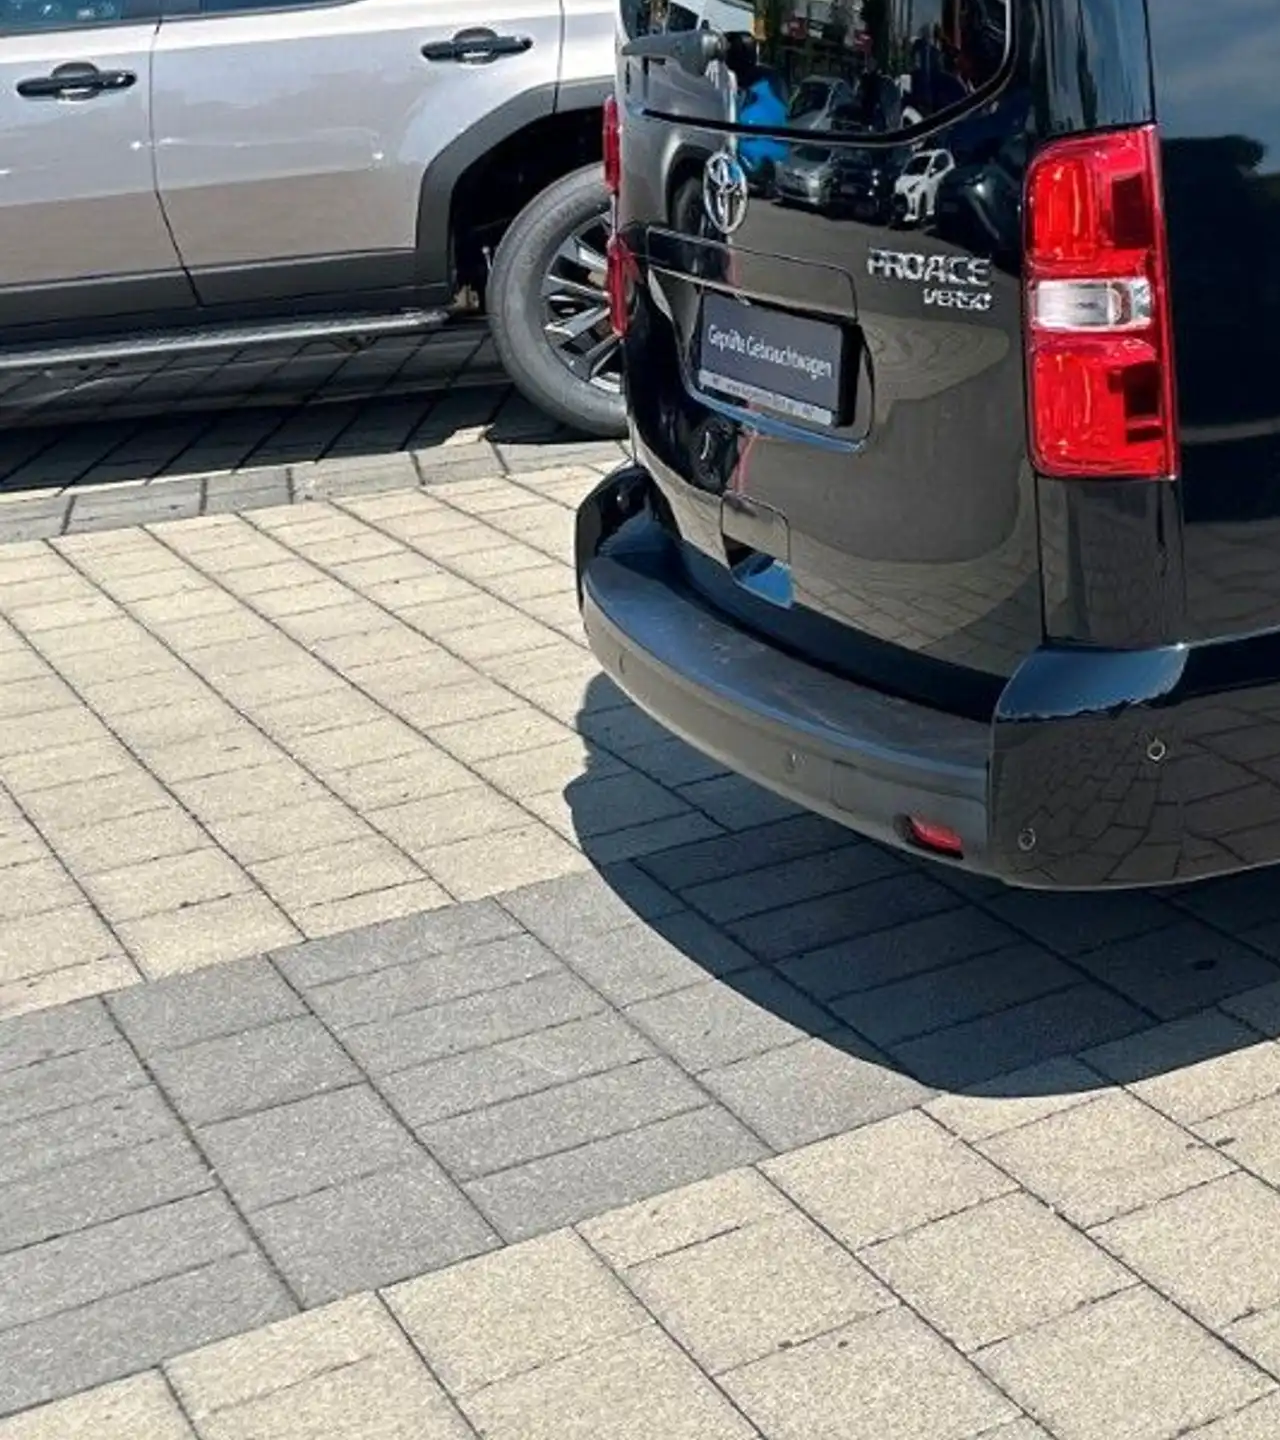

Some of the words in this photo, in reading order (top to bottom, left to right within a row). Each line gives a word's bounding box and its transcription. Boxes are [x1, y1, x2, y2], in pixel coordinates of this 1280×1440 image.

[866, 247, 990, 286] PROACE
[923, 288, 992, 311] VERSO
[746, 335, 832, 380] Gebrauchtwagen
